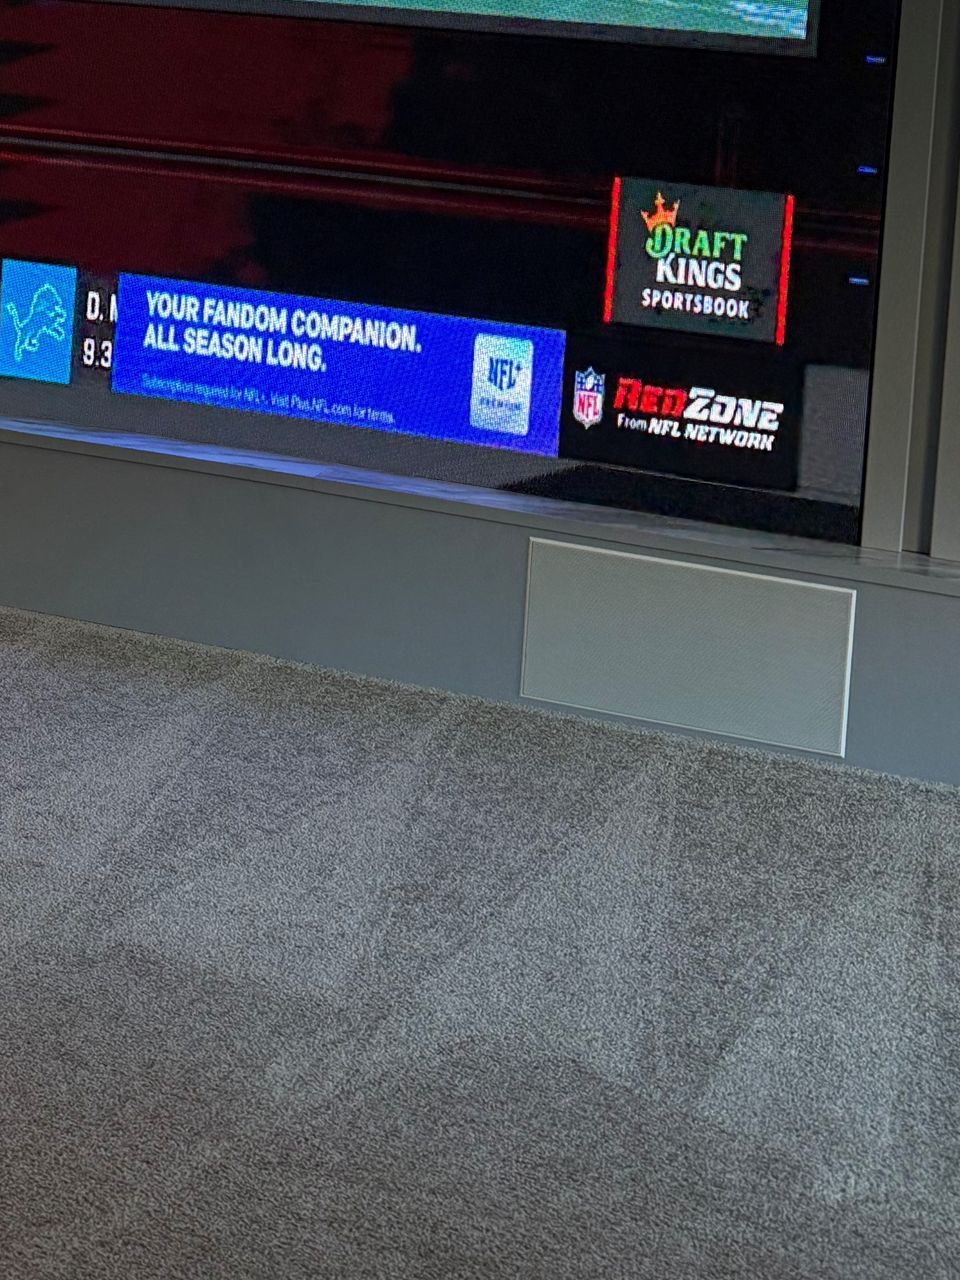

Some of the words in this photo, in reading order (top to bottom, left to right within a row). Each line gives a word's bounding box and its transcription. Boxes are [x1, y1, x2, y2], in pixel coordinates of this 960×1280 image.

[645, 223, 748, 260] DRAFT
[655, 252, 742, 291] KINGS
[145, 289, 200, 323] YOUR
[202, 297, 288, 336] FANDOM
[290, 310, 423, 354] COMPANION.
[641, 288, 750, 319] SPORTSBOOK
[143, 324, 180, 352] ALL
[183, 329, 263, 364] SEASON
[267, 341, 328, 373] LONG.
[577, 393, 599, 415] NFL
[617, 413, 647, 432] From
[648, 417, 681, 439] NFL
[684, 423, 775, 451] NETWORK
